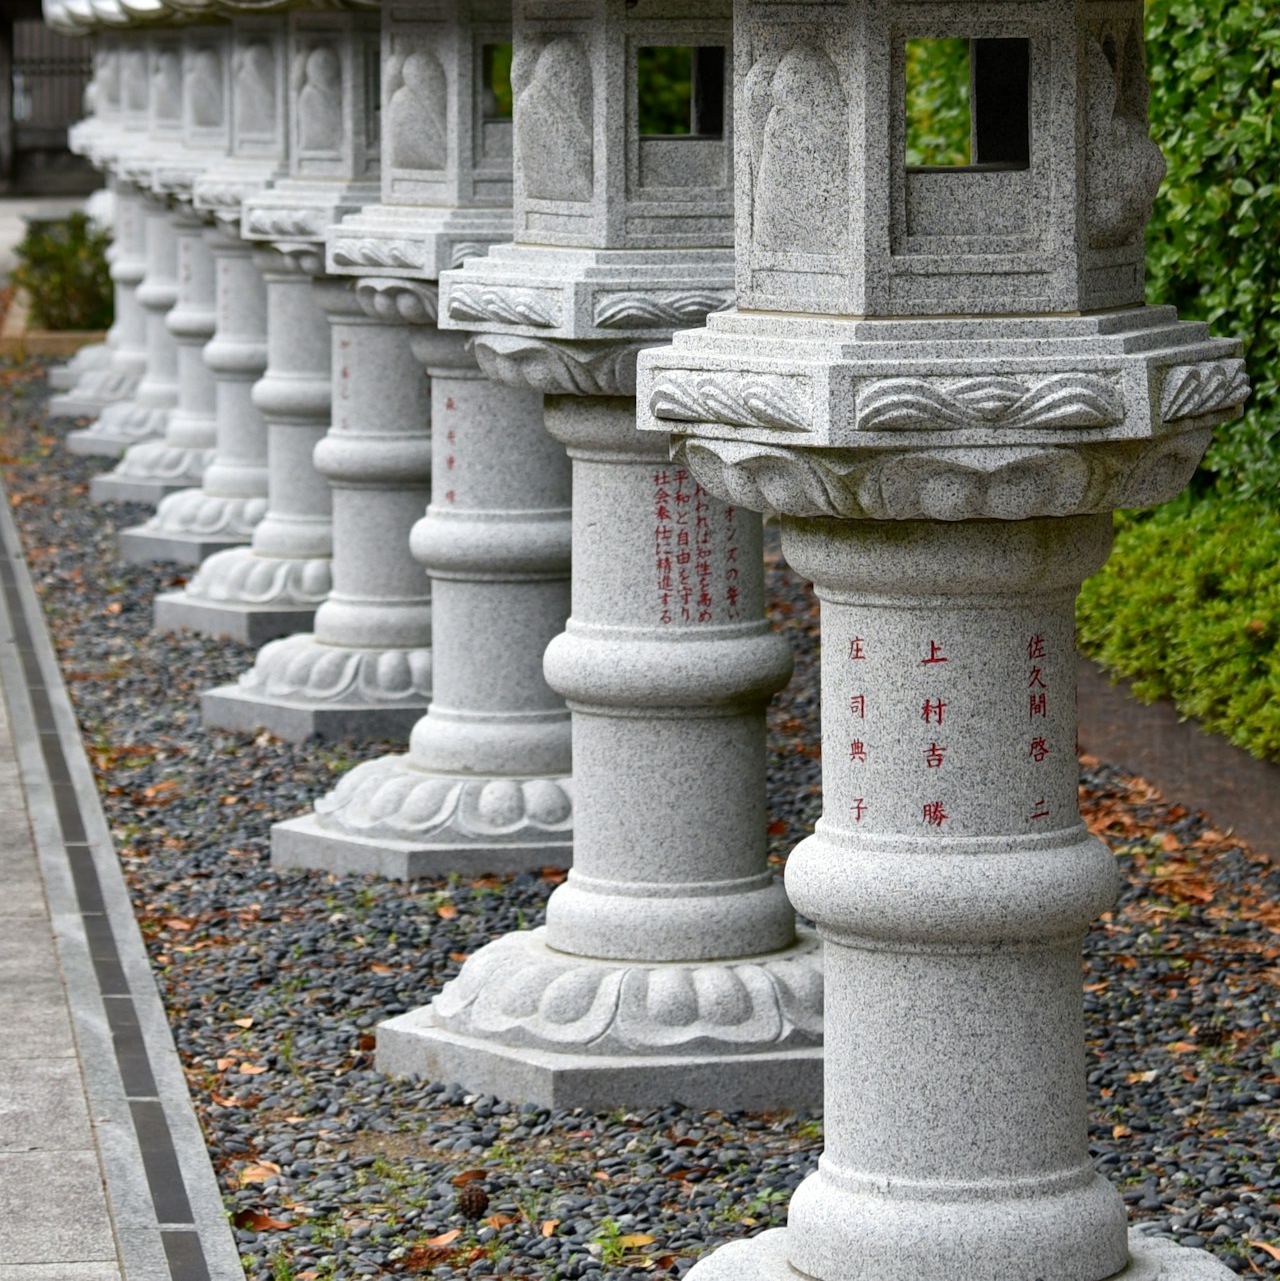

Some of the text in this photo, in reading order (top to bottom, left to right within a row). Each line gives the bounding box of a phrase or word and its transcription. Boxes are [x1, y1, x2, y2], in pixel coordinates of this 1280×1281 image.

[653, 470, 673, 624] 社会奉仕に精進する
[674, 470, 693, 622] 平和と自由を守り
[695, 482, 713, 623] れわれは知性を高め
[725, 506, 740, 621] オンズの誓い
[848, 637, 868, 823] 庄司典子
[921, 640, 949, 827] 上村吉勝
[1027, 636, 1050, 820] 佐久間啓二
